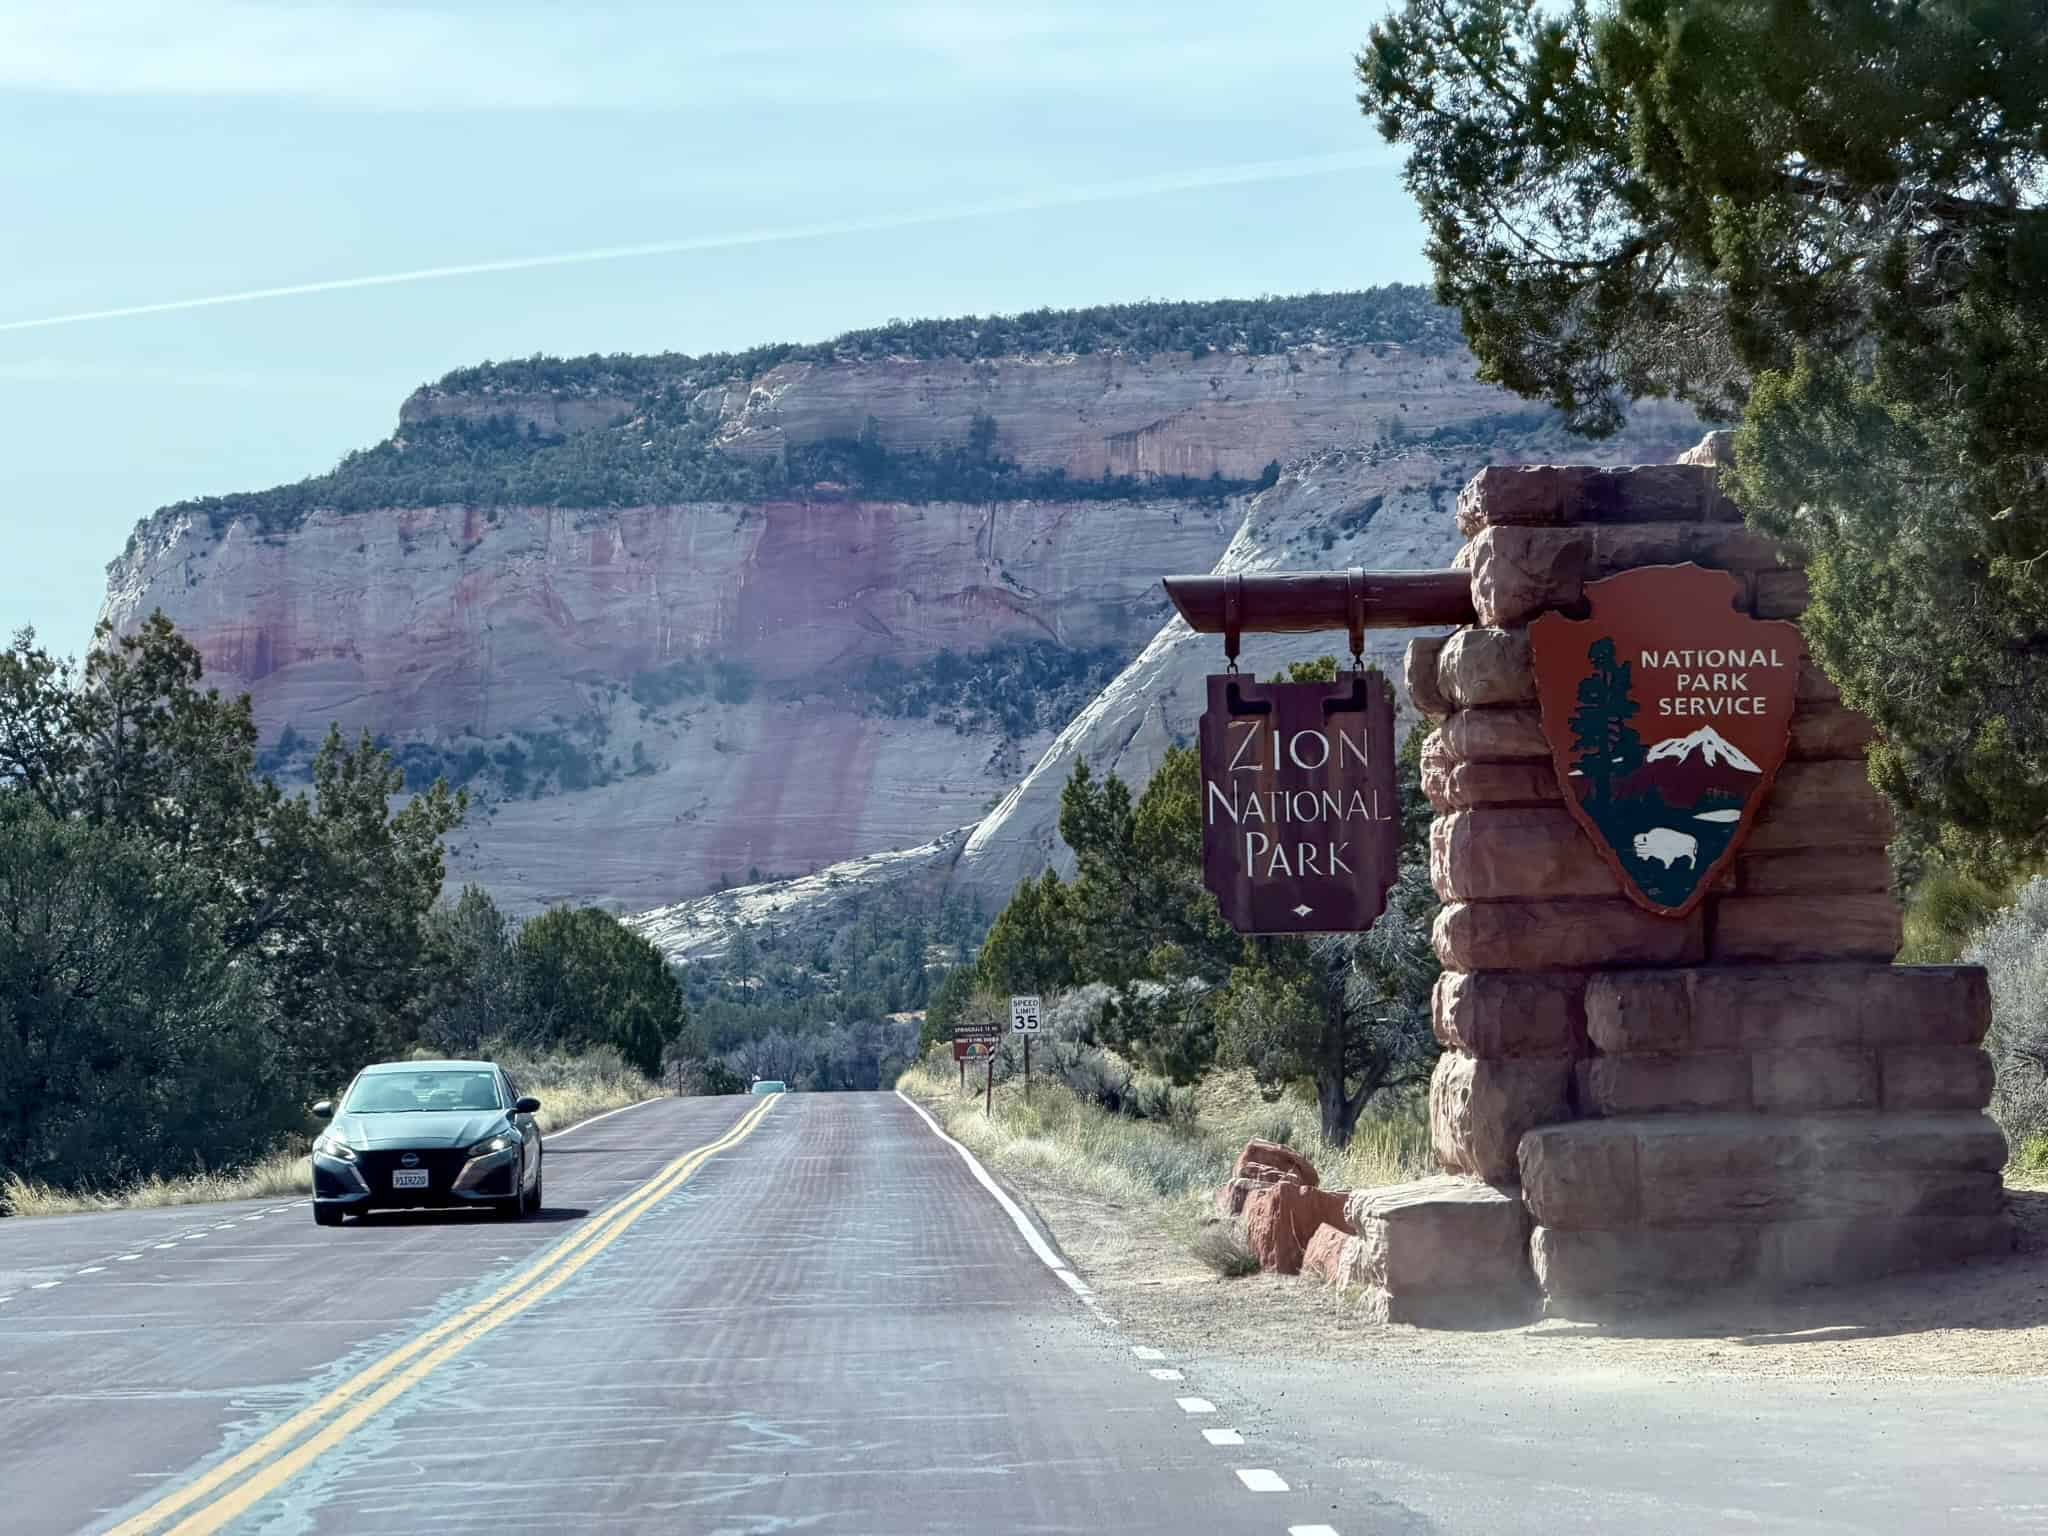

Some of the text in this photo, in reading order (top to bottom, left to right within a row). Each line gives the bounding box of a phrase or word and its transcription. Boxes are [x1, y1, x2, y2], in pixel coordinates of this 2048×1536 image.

[1640, 648, 1785, 668] NATIONAL
[1677, 672, 1749, 691] PARK
[1658, 696, 1768, 716] SERVICE
[1227, 719, 1369, 772] ZION
[1207, 779, 1392, 825] NATIONAL
[1245, 831, 1353, 878] PARK
[1013, 999, 1039, 1007] SPEED
[1015, 1007, 1036, 1015] LIMIT
[1014, 1015, 1039, 1030] 35
